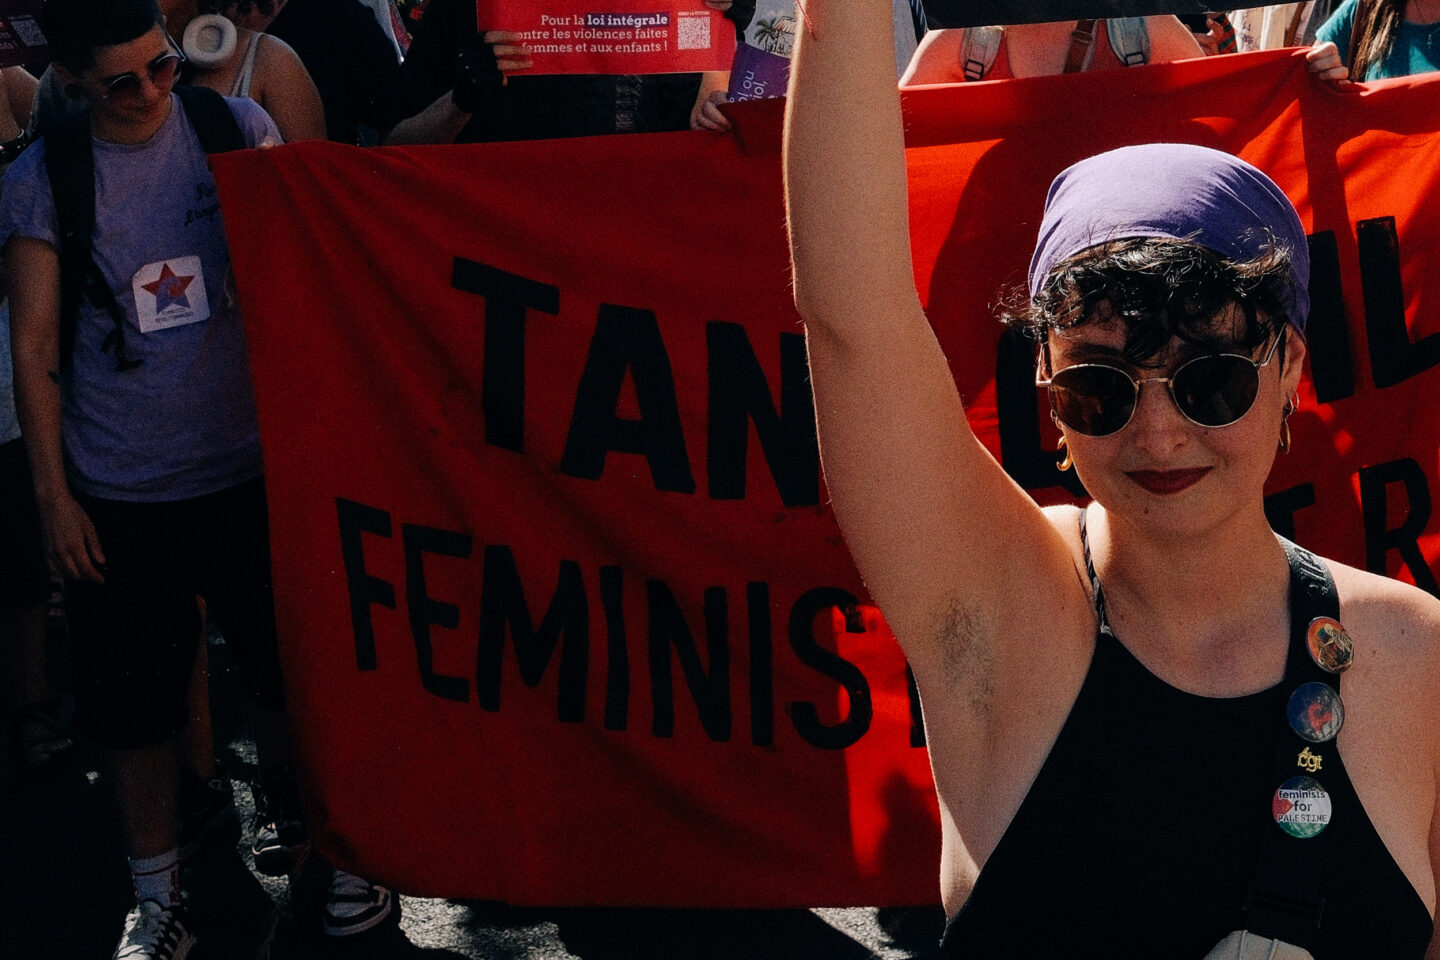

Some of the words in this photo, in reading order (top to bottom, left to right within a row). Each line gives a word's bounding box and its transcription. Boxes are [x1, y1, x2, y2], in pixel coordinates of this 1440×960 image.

[541, 15, 571, 27] Pour
[573, 15, 585, 27] la
[587, 14, 605, 25] loi
[607, 13, 668, 29] intégrale
[517, 29, 550, 40] ontre
[552, 28, 571, 39] les
[573, 28, 633, 40] violences
[634, 27, 668, 39] faites
[576, 42, 589, 53] et
[590, 43, 613, 53] aux
[615, 41, 659, 53] enfants
[663, 41, 668, 52] !
[451, 255, 820, 508] TAN
[336, 497, 928, 751] FEMINIS
[1278, 790, 1326, 799] feminists
[1294, 800, 1312, 812] for
[1278, 814, 1328, 823] PALESTINE
